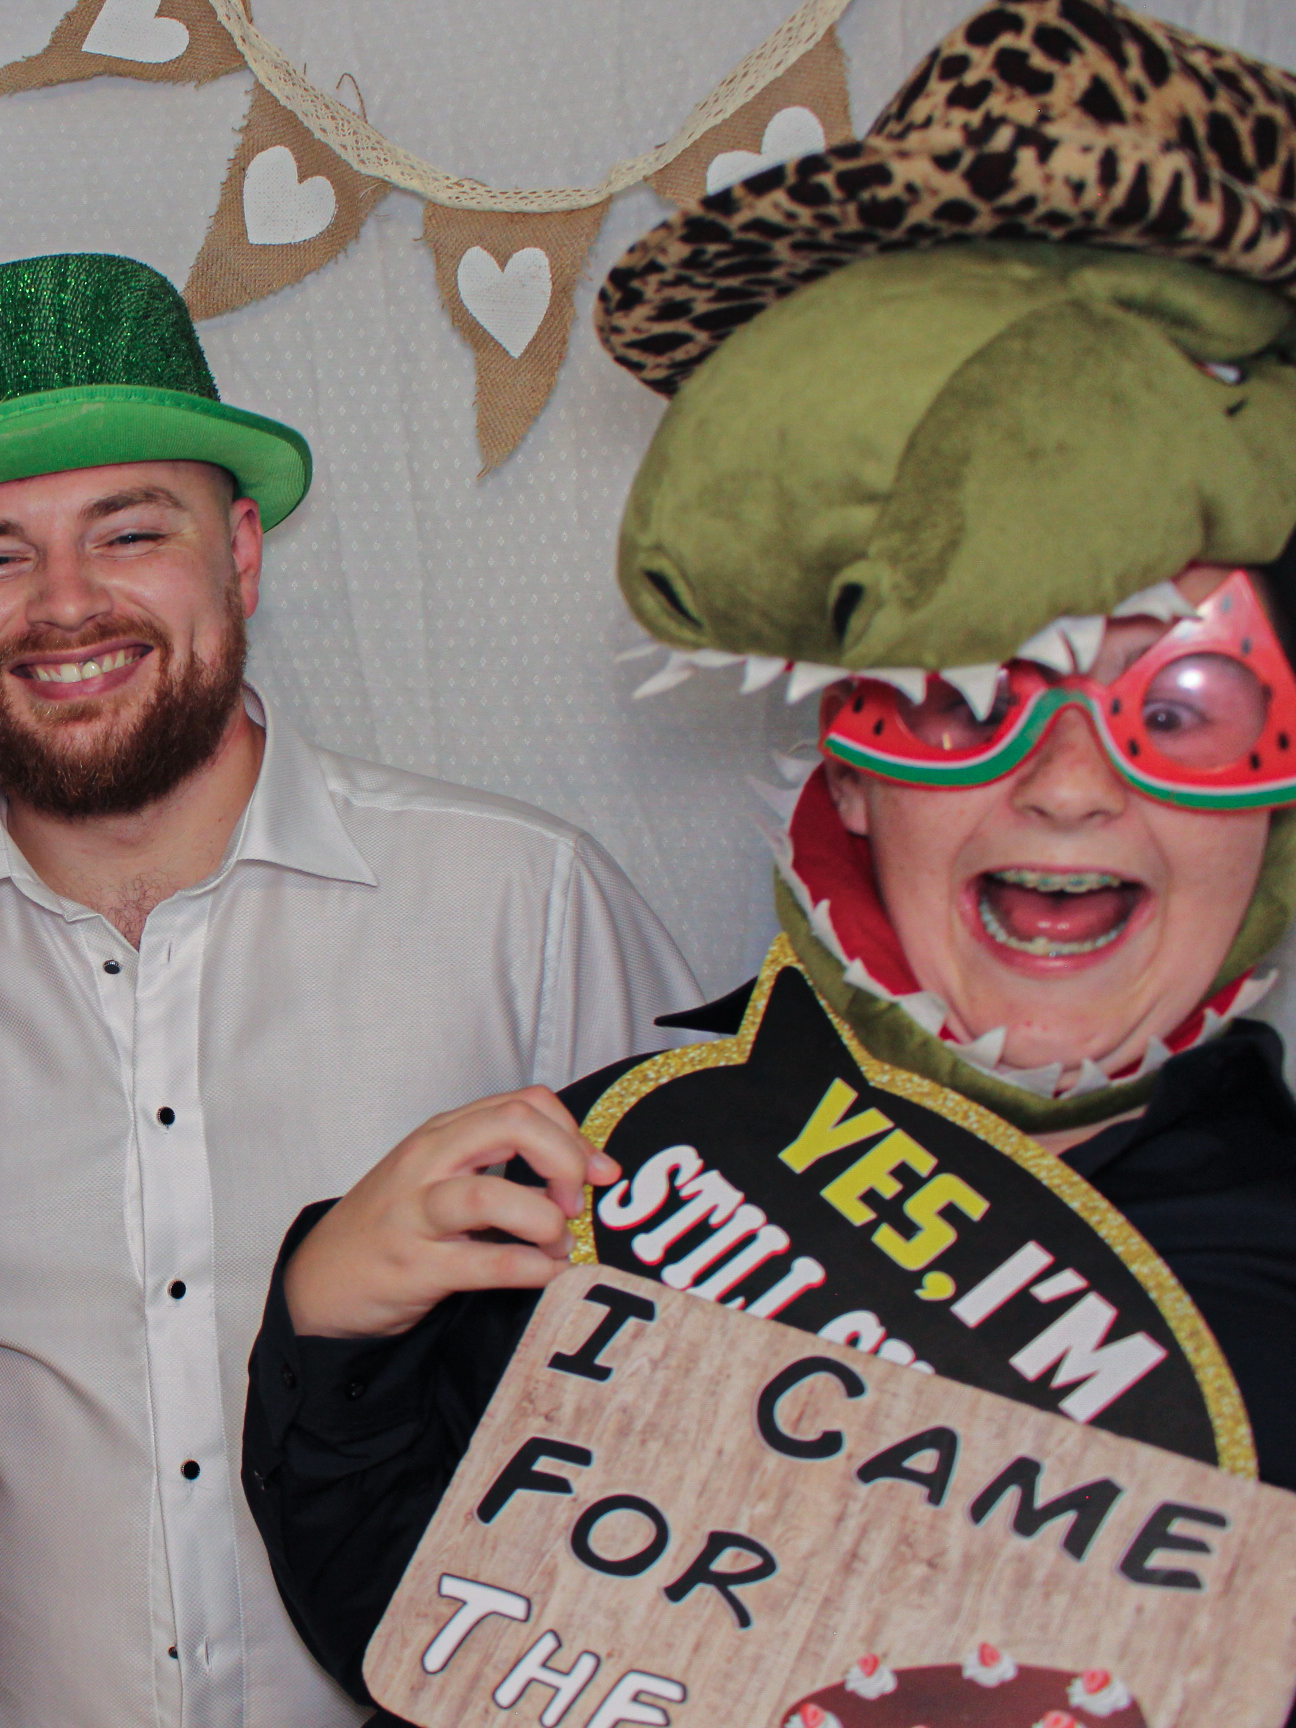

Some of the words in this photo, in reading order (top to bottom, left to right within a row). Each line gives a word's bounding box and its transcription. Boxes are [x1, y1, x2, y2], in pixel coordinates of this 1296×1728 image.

[778, 1077, 990, 1301] YES,
[949, 1240, 1168, 1425] I'M
[476, 1436, 778, 1630] FOR
[547, 1283, 656, 1382] I
[756, 1355, 1230, 1591] CAME
